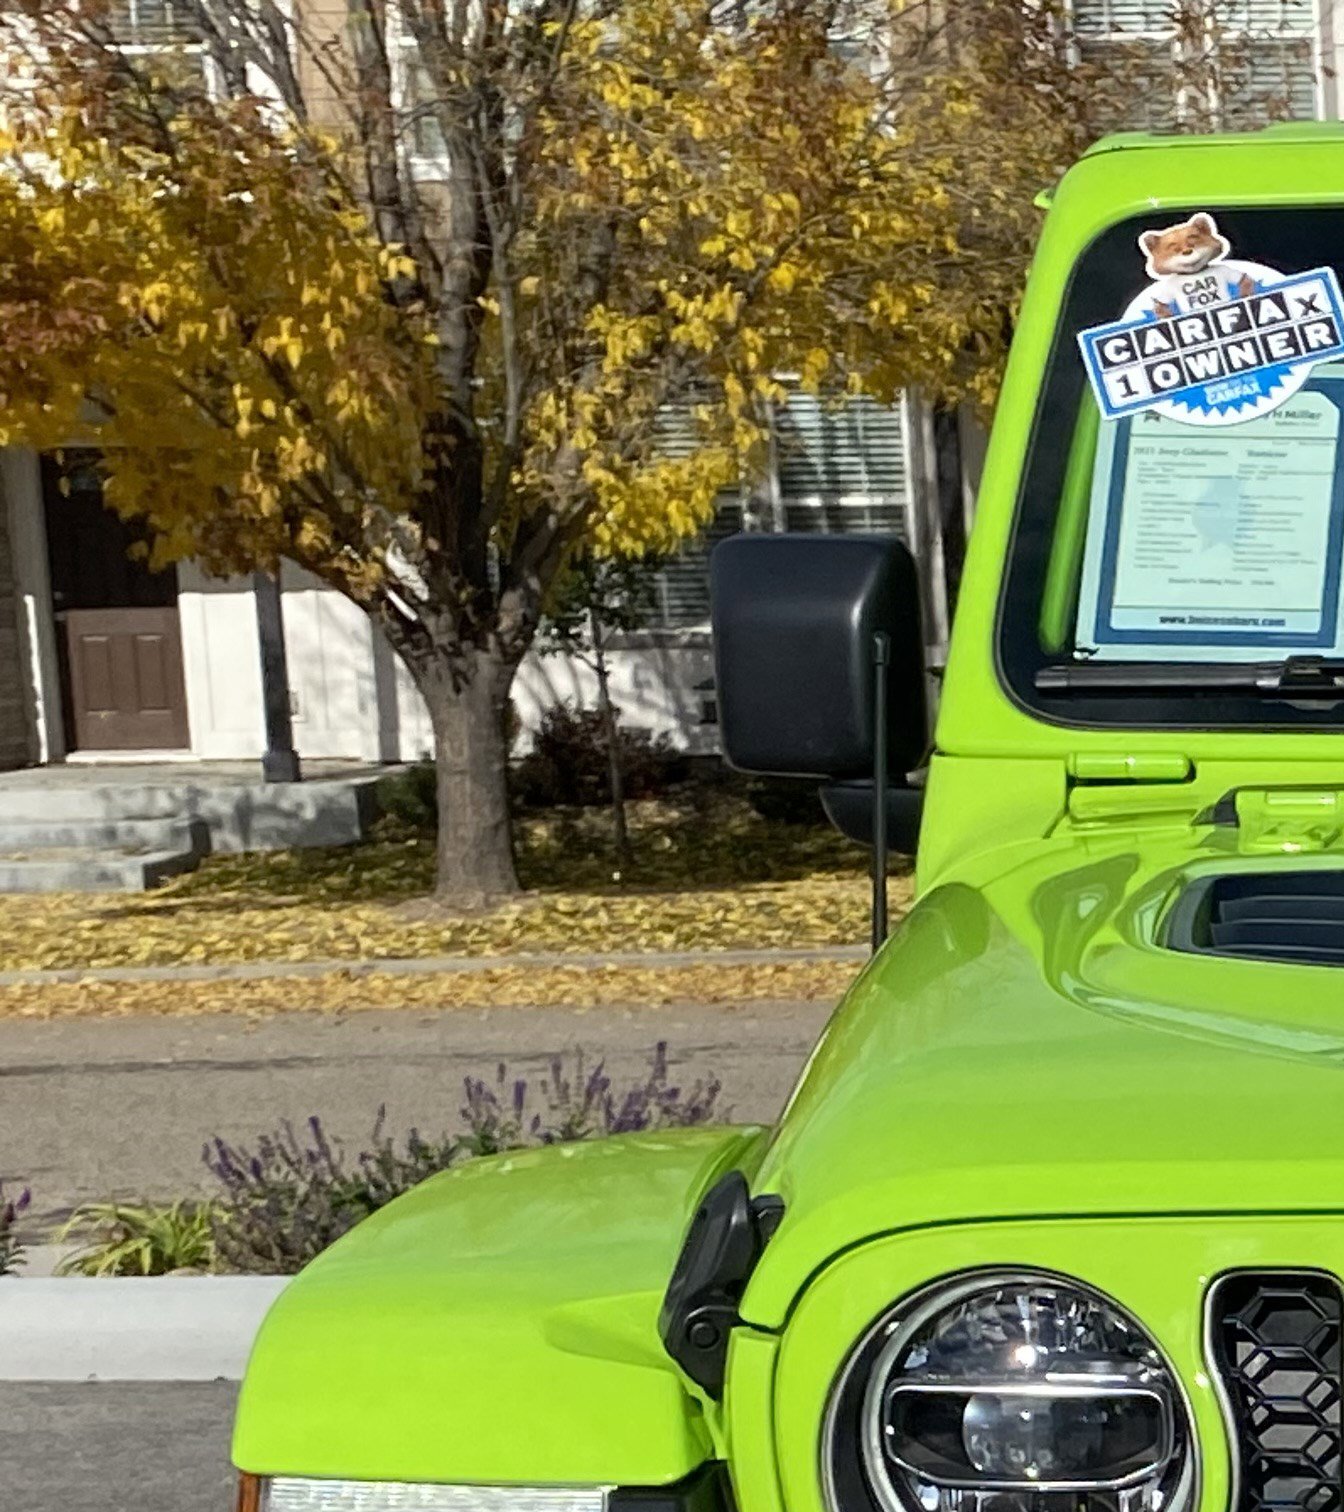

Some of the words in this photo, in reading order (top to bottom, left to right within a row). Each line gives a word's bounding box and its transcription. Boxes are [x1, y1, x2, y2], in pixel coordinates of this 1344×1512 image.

[1182, 275, 1219, 296] CAR
[1187, 290, 1222, 309] FOX
[1103, 292, 1324, 363] CARFAX
